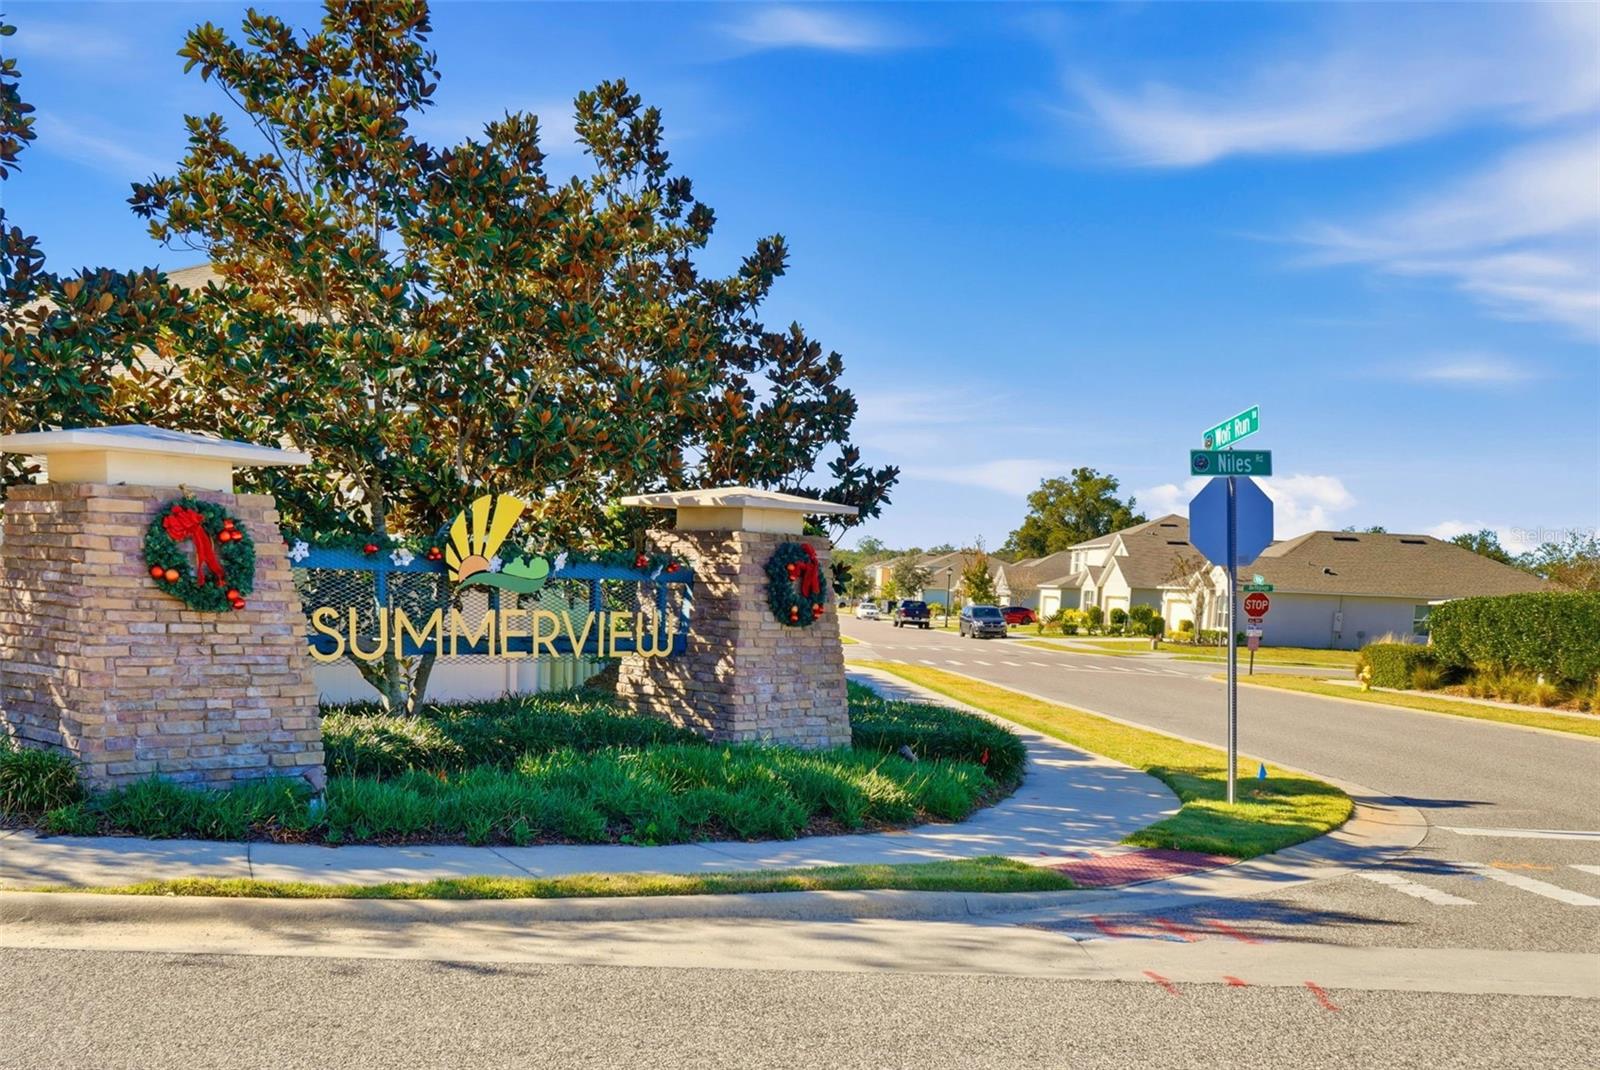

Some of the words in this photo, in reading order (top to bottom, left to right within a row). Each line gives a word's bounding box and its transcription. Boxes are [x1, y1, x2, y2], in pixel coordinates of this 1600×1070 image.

[1235, 418, 1250, 438] Run
[1218, 453, 1252, 472] Niles
[1245, 600, 1268, 610] STOP
[308, 606, 674, 661] SUMMERVIEW
